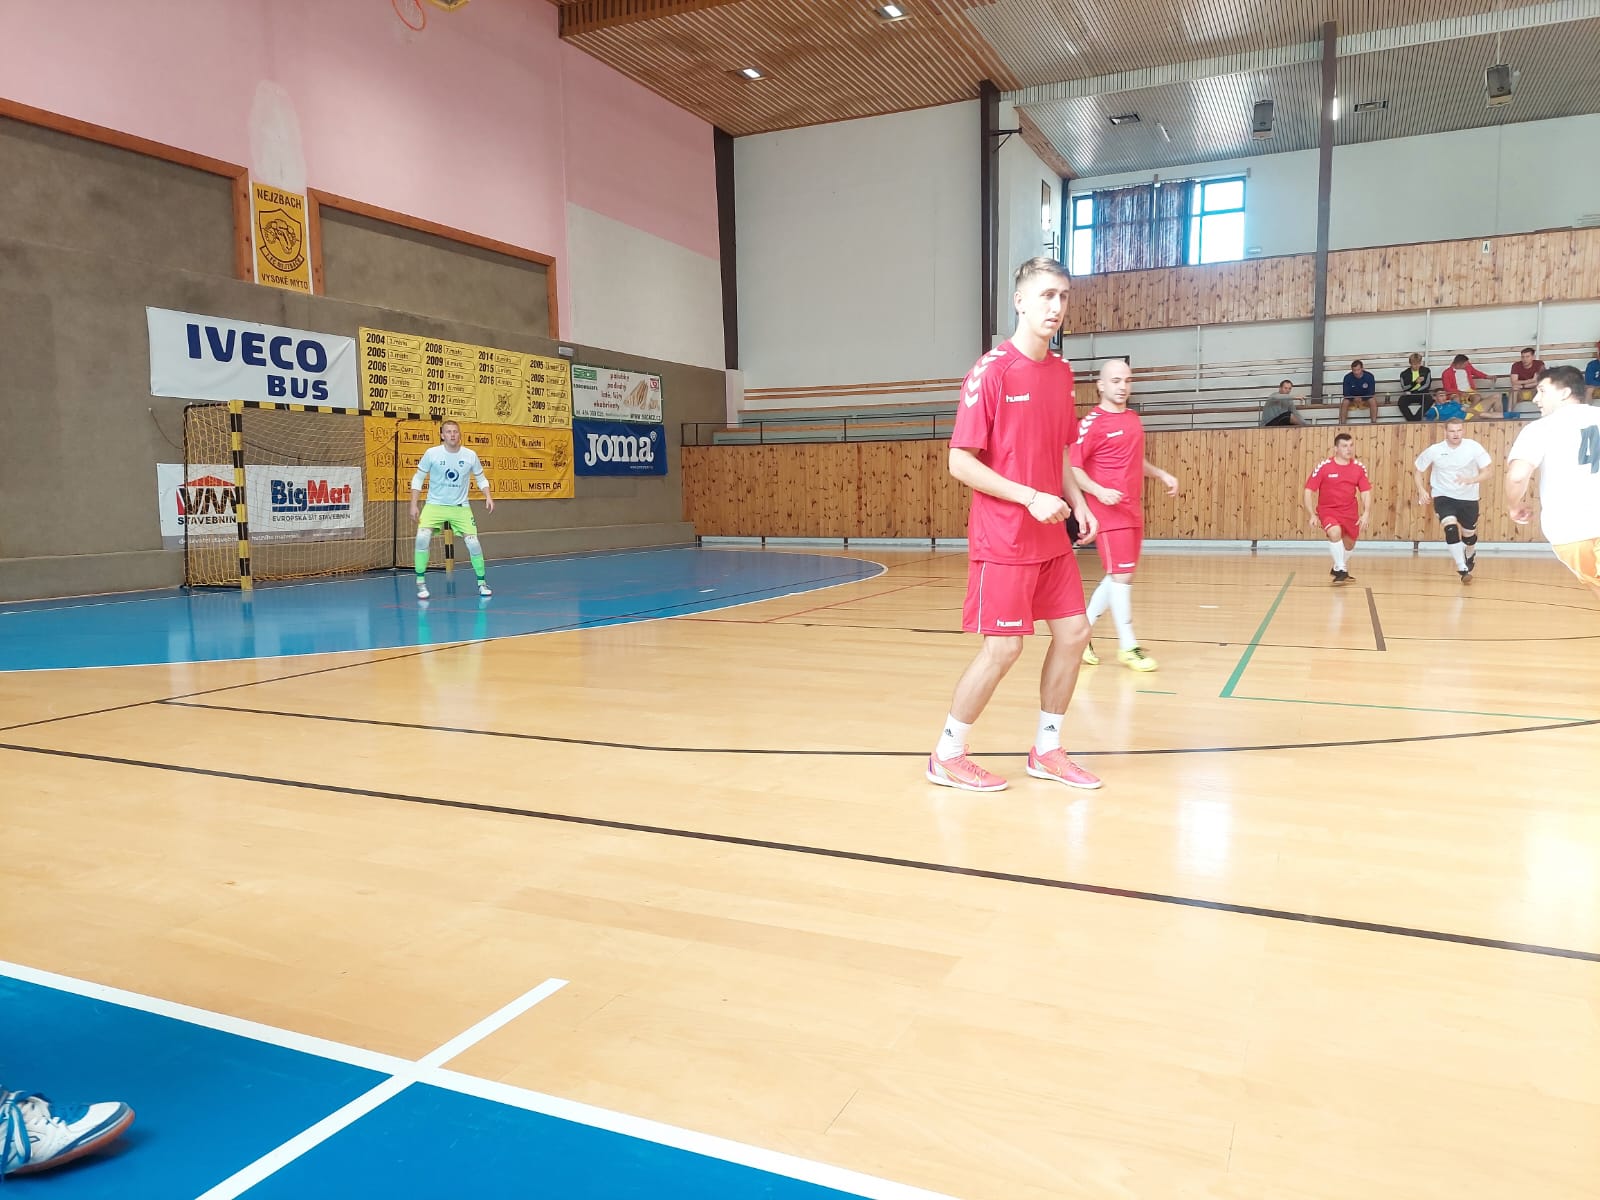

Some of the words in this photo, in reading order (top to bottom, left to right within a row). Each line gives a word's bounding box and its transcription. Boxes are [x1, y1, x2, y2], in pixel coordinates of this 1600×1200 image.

[256, 188, 302, 210] NEJZBACH
[262, 273, 288, 286] VYSOKÉ
[366, 333, 385, 344] 2004
[187, 324, 328, 373] IVECO
[367, 346, 386, 358] 2005
[426, 342, 442, 354] 2008
[426, 356, 443, 366] 2009
[479, 351, 494, 360] 2014
[368, 360, 386, 372] 2006
[479, 363, 494, 373] 2015
[427, 368, 444, 379] 2010
[369, 374, 388, 385] 2006
[480, 375, 494, 384] 2016
[267, 375, 329, 400] BUS
[428, 381, 444, 392] 2011
[532, 387, 544, 396] 2007
[370, 388, 388, 398] 2007
[428, 394, 445, 404] 2012
[370, 401, 390, 411] 2007
[429, 406, 446, 416] 2013
[532, 415, 545, 423] 2011
[1578, 424, 1600, 474] 4
[270, 480, 352, 512] BigMat
[178, 516, 238, 525] STAVEBNIN
